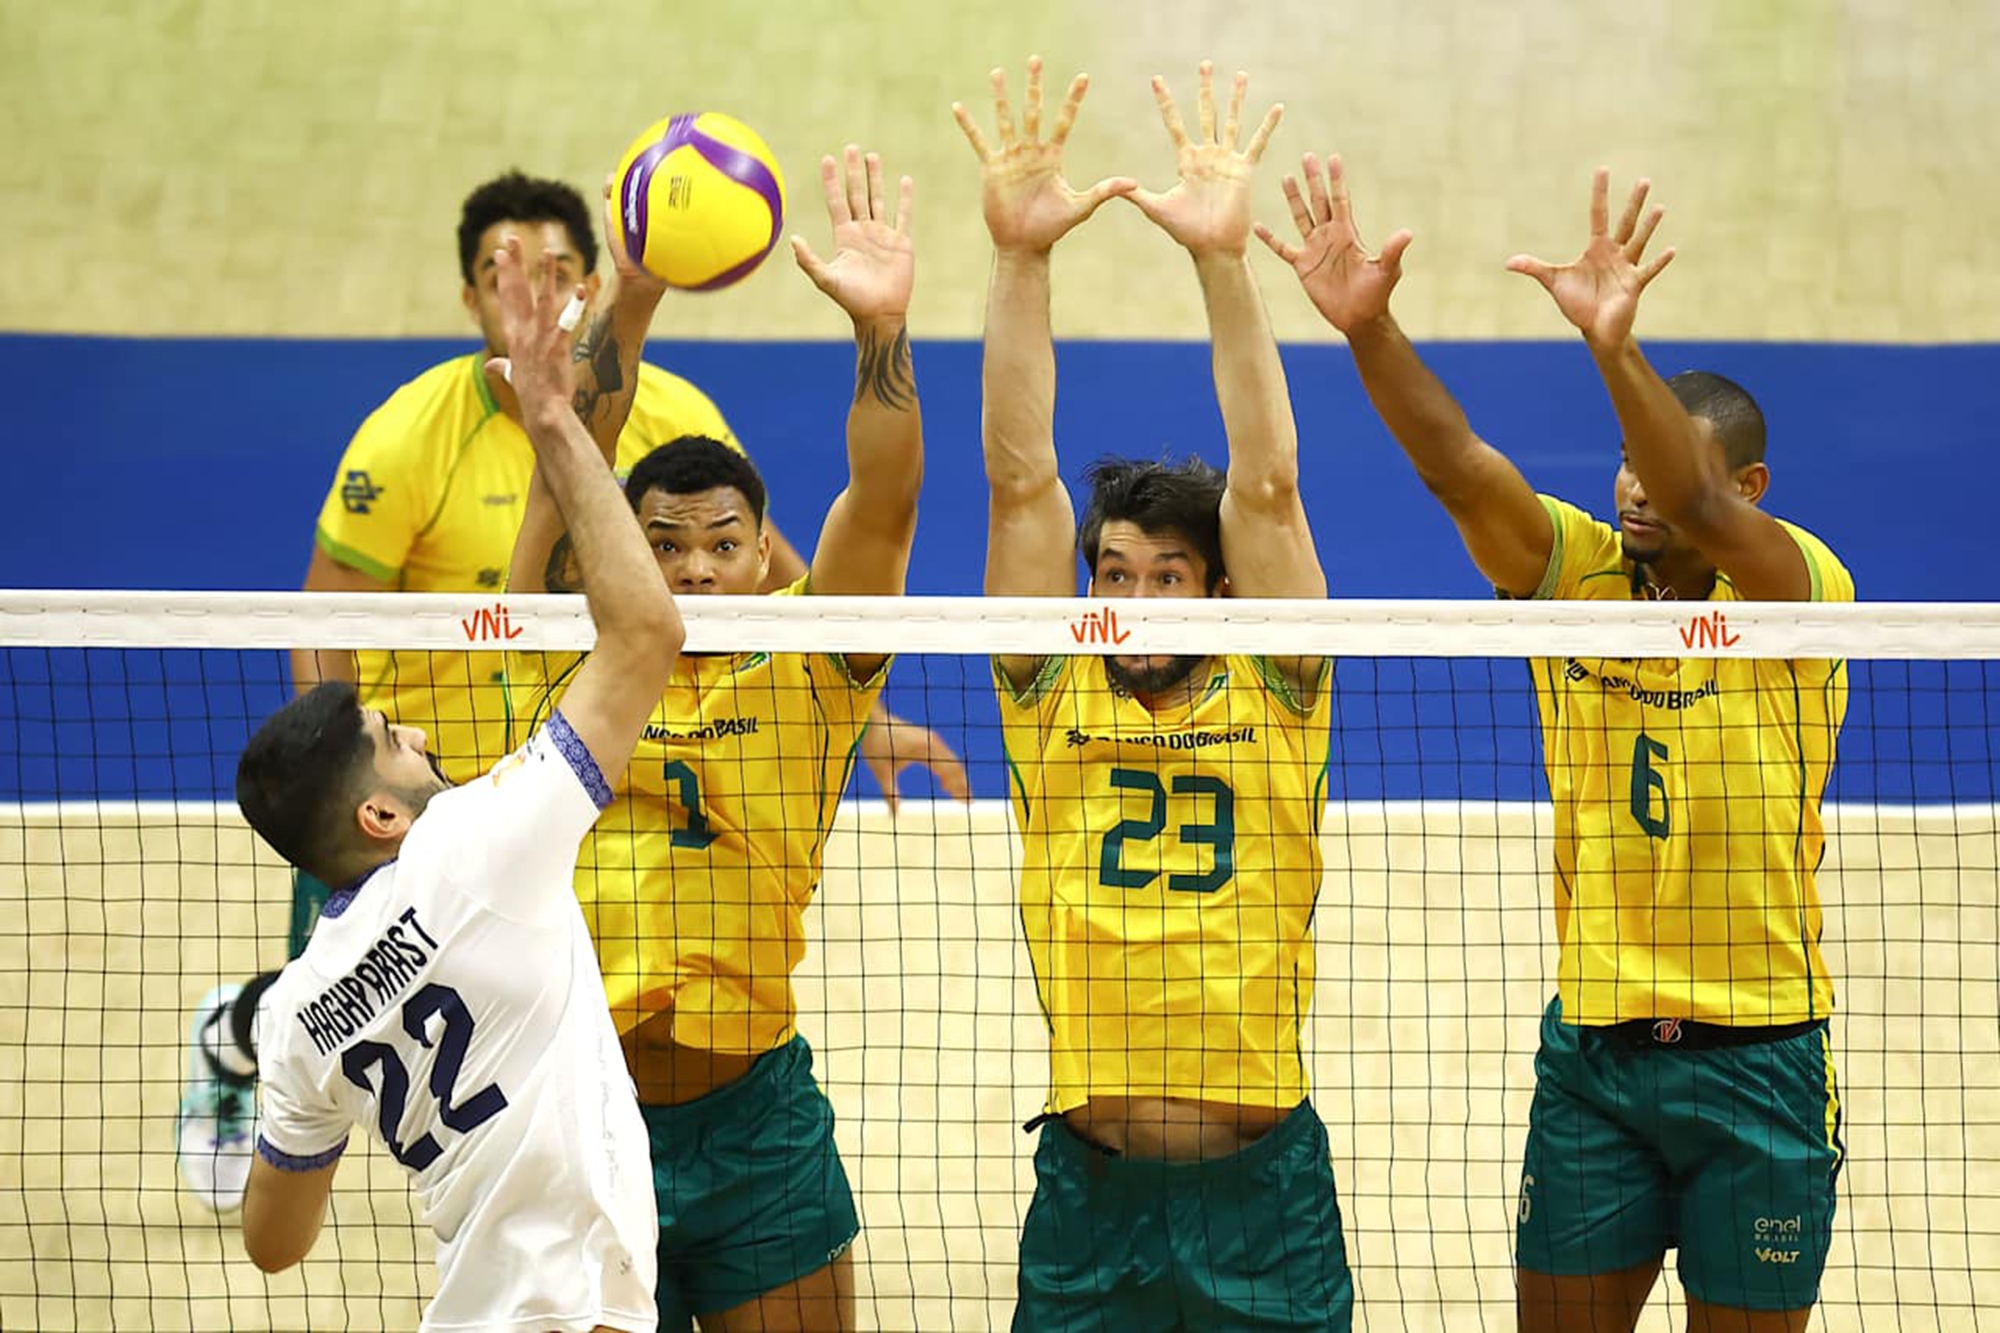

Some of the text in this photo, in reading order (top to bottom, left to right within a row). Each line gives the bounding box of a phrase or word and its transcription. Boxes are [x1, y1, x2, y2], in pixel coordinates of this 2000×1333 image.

[462, 603, 523, 641] VNL
[1070, 606, 1131, 645] VNL
[1679, 610, 1741, 649] VNL
[1169, 733, 1194, 750] DO
[663, 759, 721, 850] 1
[1630, 731, 1671, 841] 6
[1099, 767, 1235, 894] 23
[297, 905, 439, 1056] HAGHPARAST
[341, 982, 509, 1173] 22
[1754, 1214, 1801, 1233] enel
[1755, 1247, 1801, 1263] VOLT
